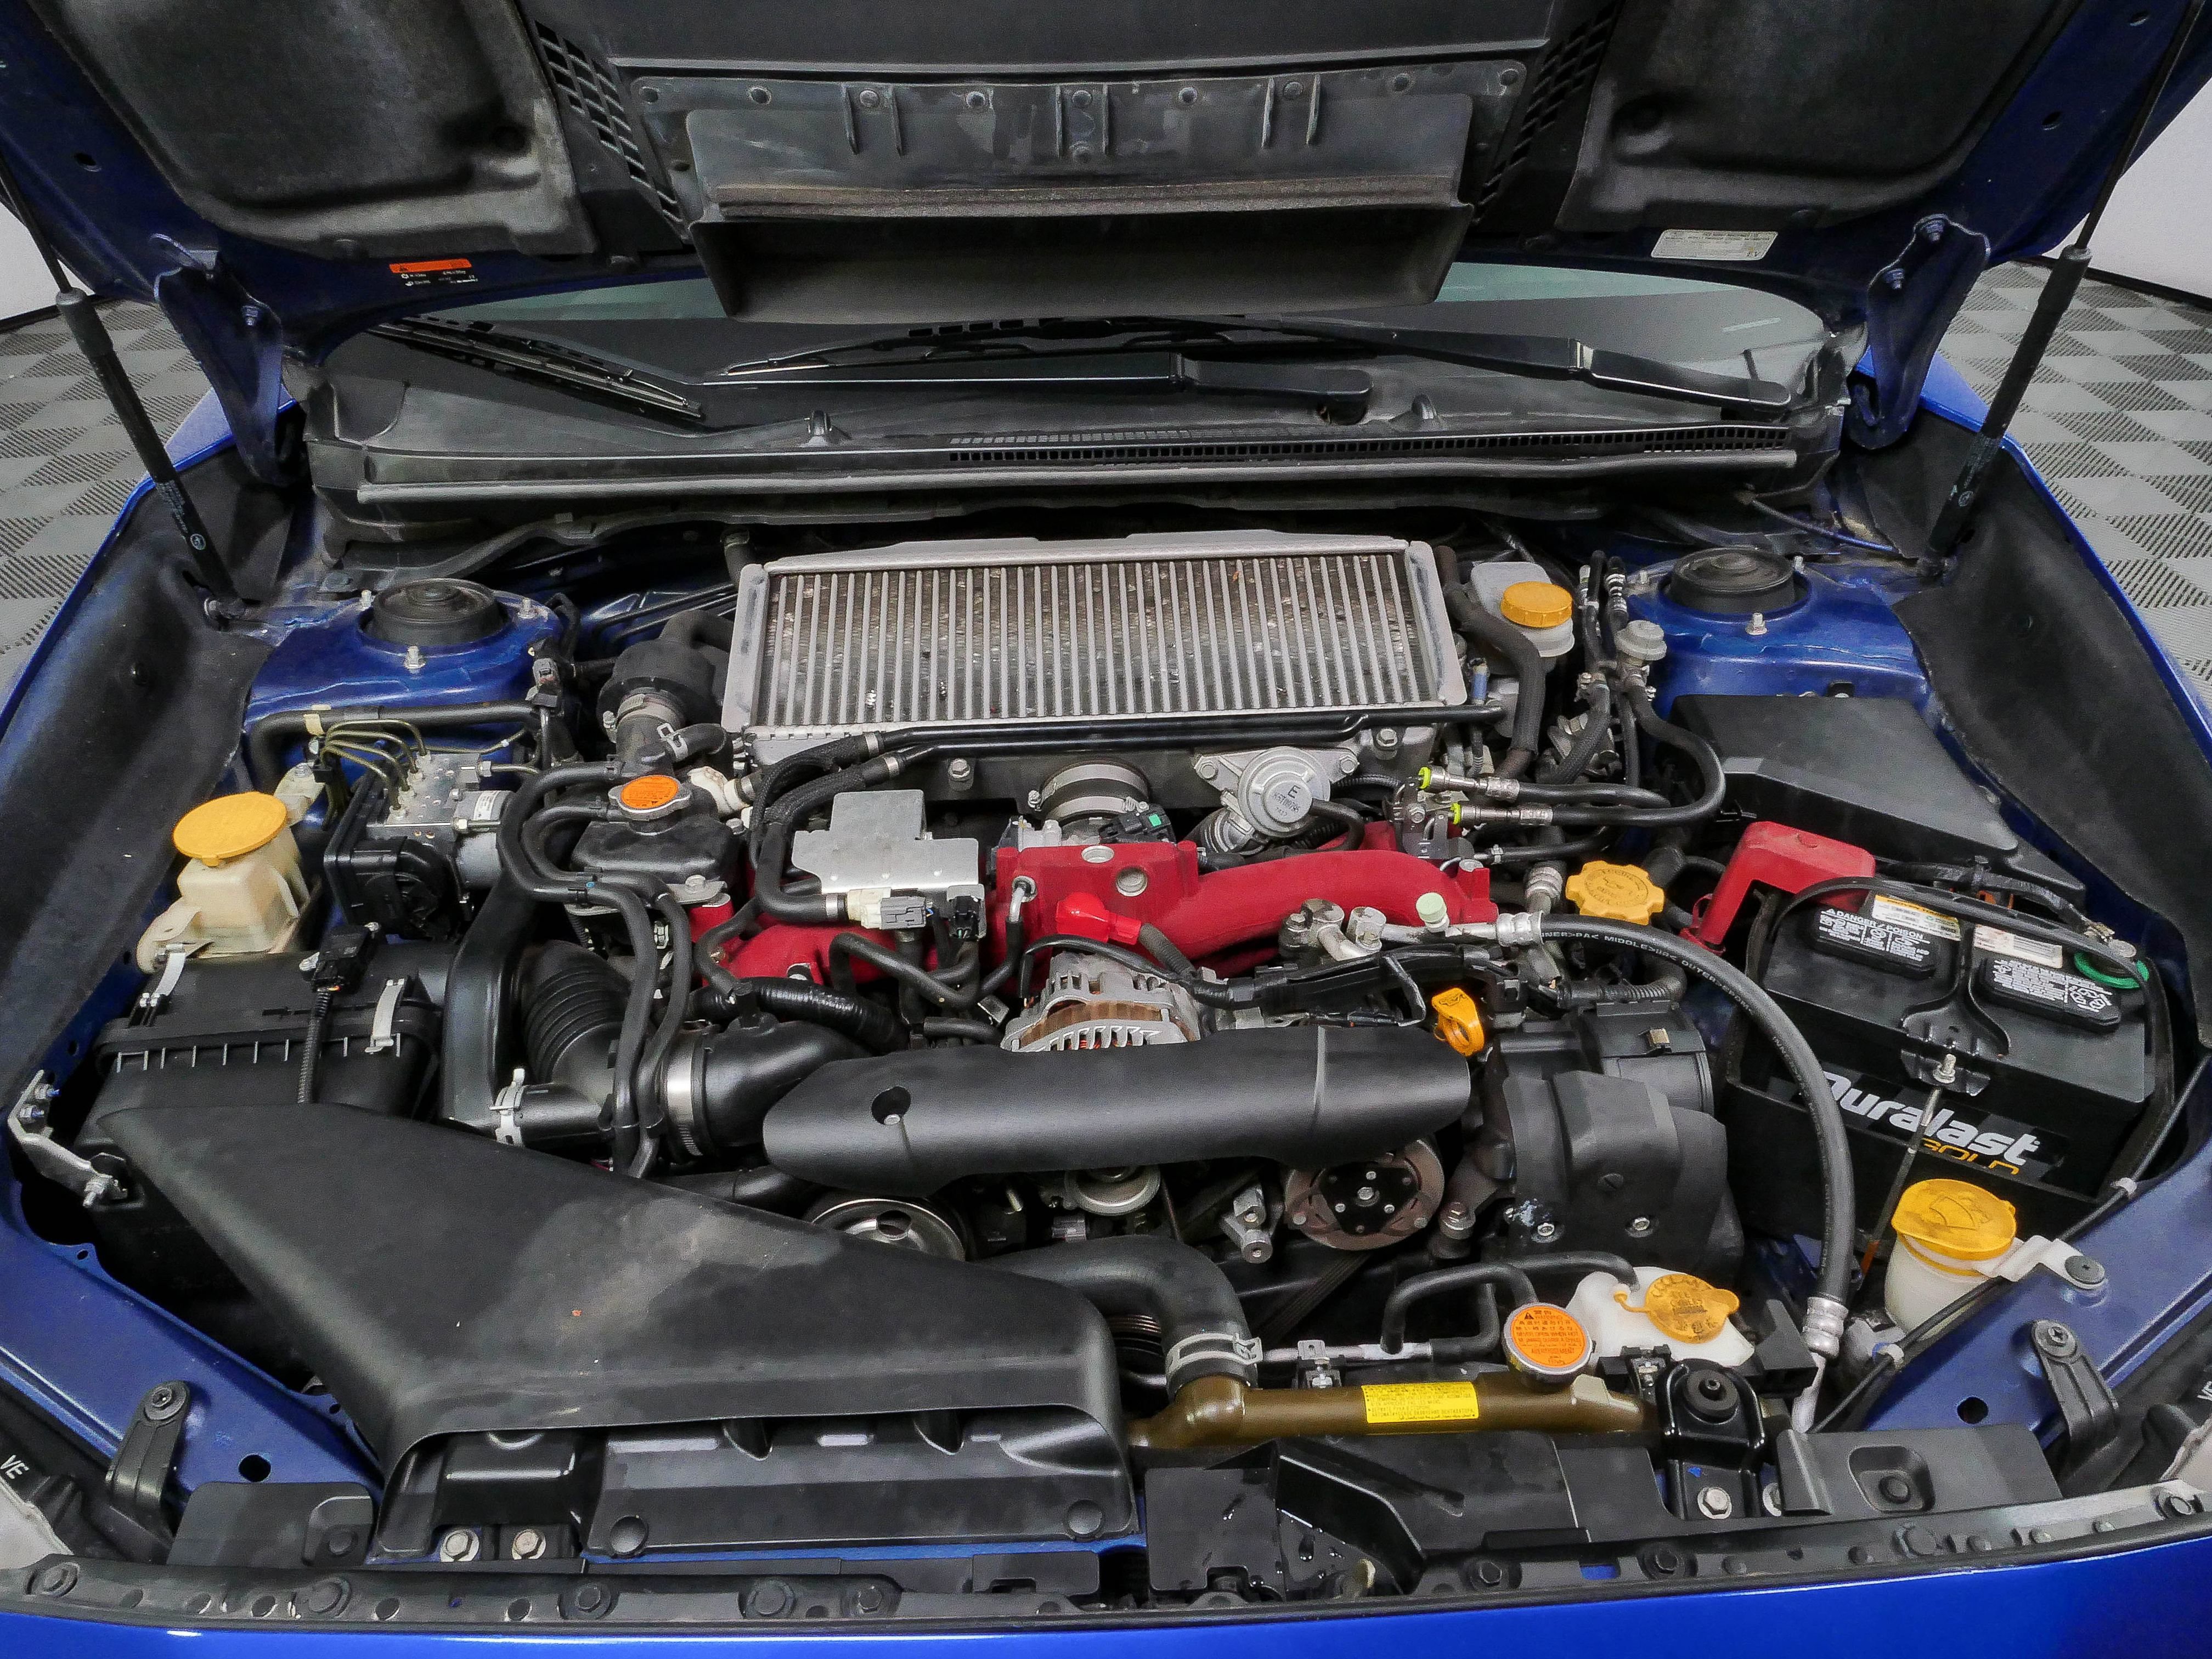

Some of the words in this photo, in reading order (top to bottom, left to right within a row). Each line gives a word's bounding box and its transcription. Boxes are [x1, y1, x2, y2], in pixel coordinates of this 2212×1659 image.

[1836, 911, 1876, 927] DANGER
[1886, 924, 1924, 940] POISON
[0, 1454, 30, 1480] VE
